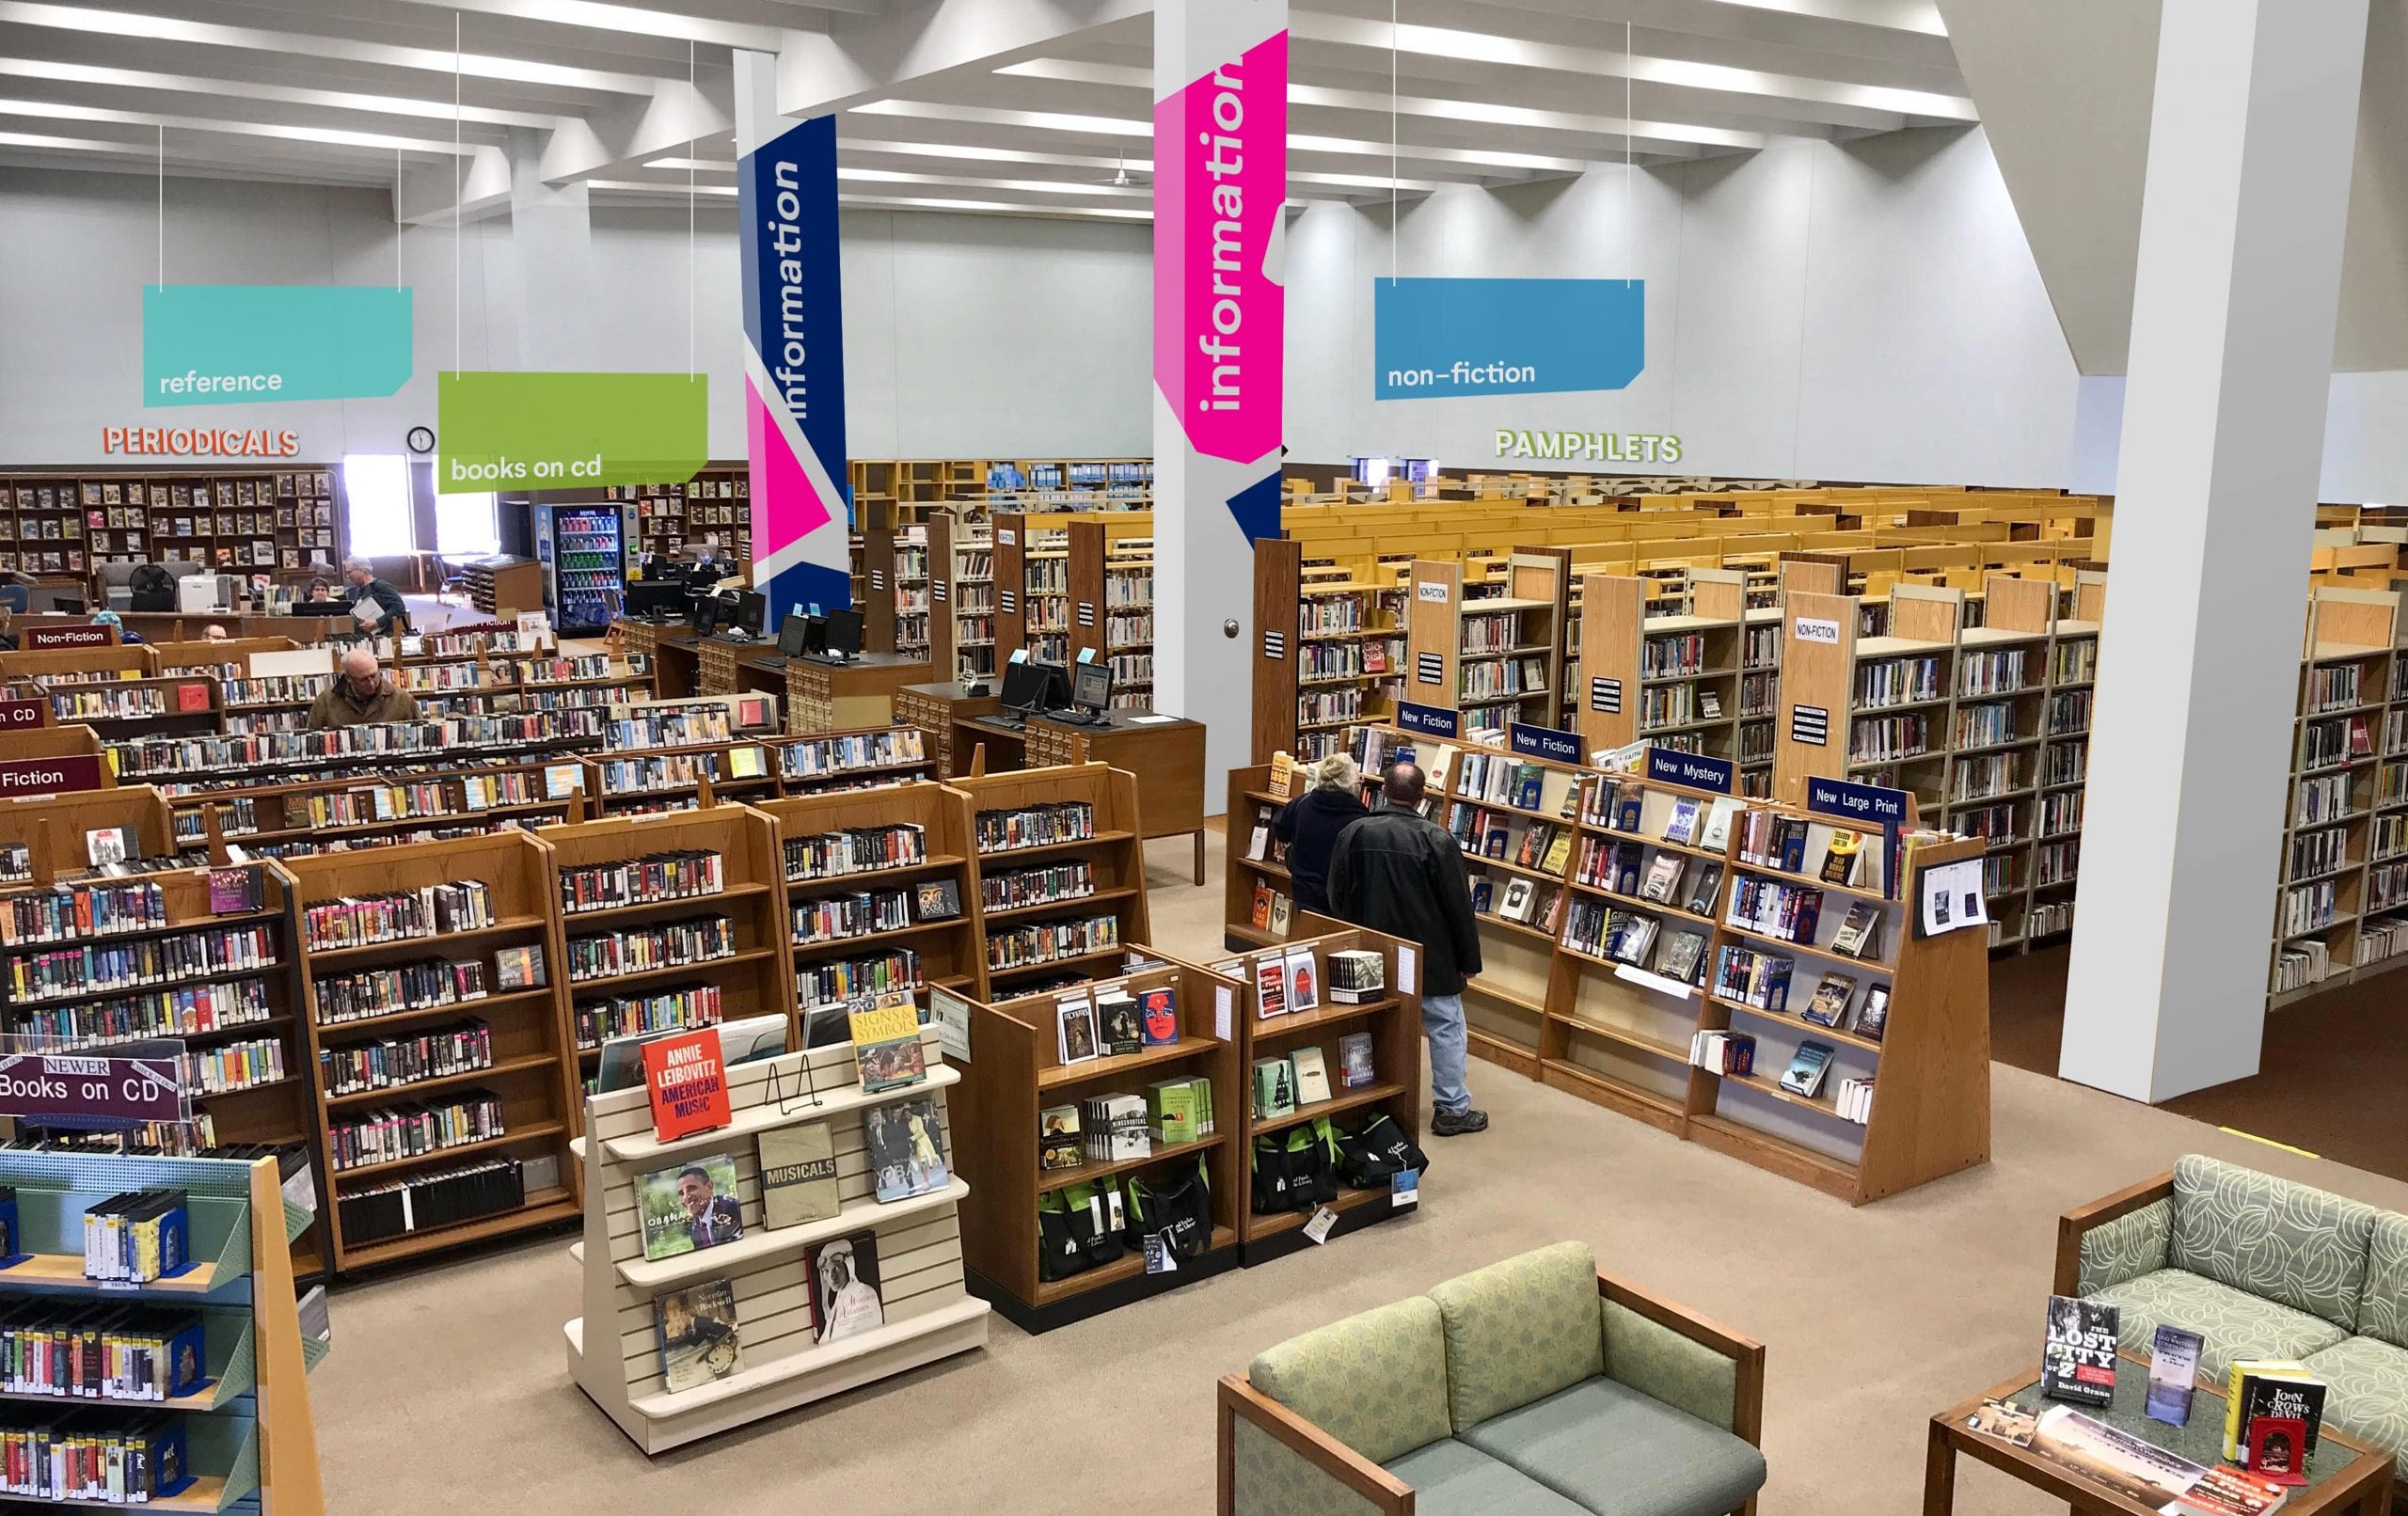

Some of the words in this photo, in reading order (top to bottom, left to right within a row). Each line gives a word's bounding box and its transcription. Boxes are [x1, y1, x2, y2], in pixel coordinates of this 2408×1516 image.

[1199, 55, 1244, 411] information
[160, 370, 282, 393] reference
[1388, 360, 1535, 387] non-fiction
[103, 427, 300, 457] PERIODICALS
[1496, 430, 1682, 463] PAMPHLETS
[452, 454, 528, 481] books
[533, 461, 564, 478] on
[571, 454, 601, 477] cd
[37, 632, 103, 644] Non-Fiction
[1798, 624, 1836, 639] NON-FICTION
[13, 708, 35, 721] CD
[1402, 710, 1418, 723] New
[1423, 714, 1452, 730] Fiction
[1516, 733, 1536, 747] New
[1543, 738, 1575, 754] Fiction
[2, 769, 64, 787] Fiction
[1656, 758, 1678, 773] New
[1684, 764, 1725, 785] Mystery
[1816, 788, 1837, 803] New
[1843, 793, 1869, 811] Large
[1876, 799, 1898, 814] Print
[1669, 824, 1691, 837] INDIGO
[856, 1009, 901, 1028] SIGNS
[858, 1019, 917, 1041] SYMBOLS
[668, 1043, 703, 1067] ANNIE
[46, 1059, 109, 1074] NEWER
[657, 1058, 717, 1088] LEIBOVITZ
[0, 1075, 68, 1099] Books
[82, 1082, 109, 1100] on
[122, 1079, 159, 1102] CD
[661, 1076, 720, 1105] AMERICAN
[674, 1097, 711, 1119] MUSIC
[766, 1161, 835, 1185] MUSICALS
[699, 1296, 732, 1312] Rockwell
[2047, 1325, 2116, 1351] LOST
[2090, 1325, 2109, 1334] THE
[2046, 1342, 2115, 1368] CITY
[2057, 1362, 2076, 1378] Z
[2057, 1381, 2083, 1393] David
[2083, 1386, 2110, 1398] Grann
[2275, 1388, 2304, 1403] JOHN
